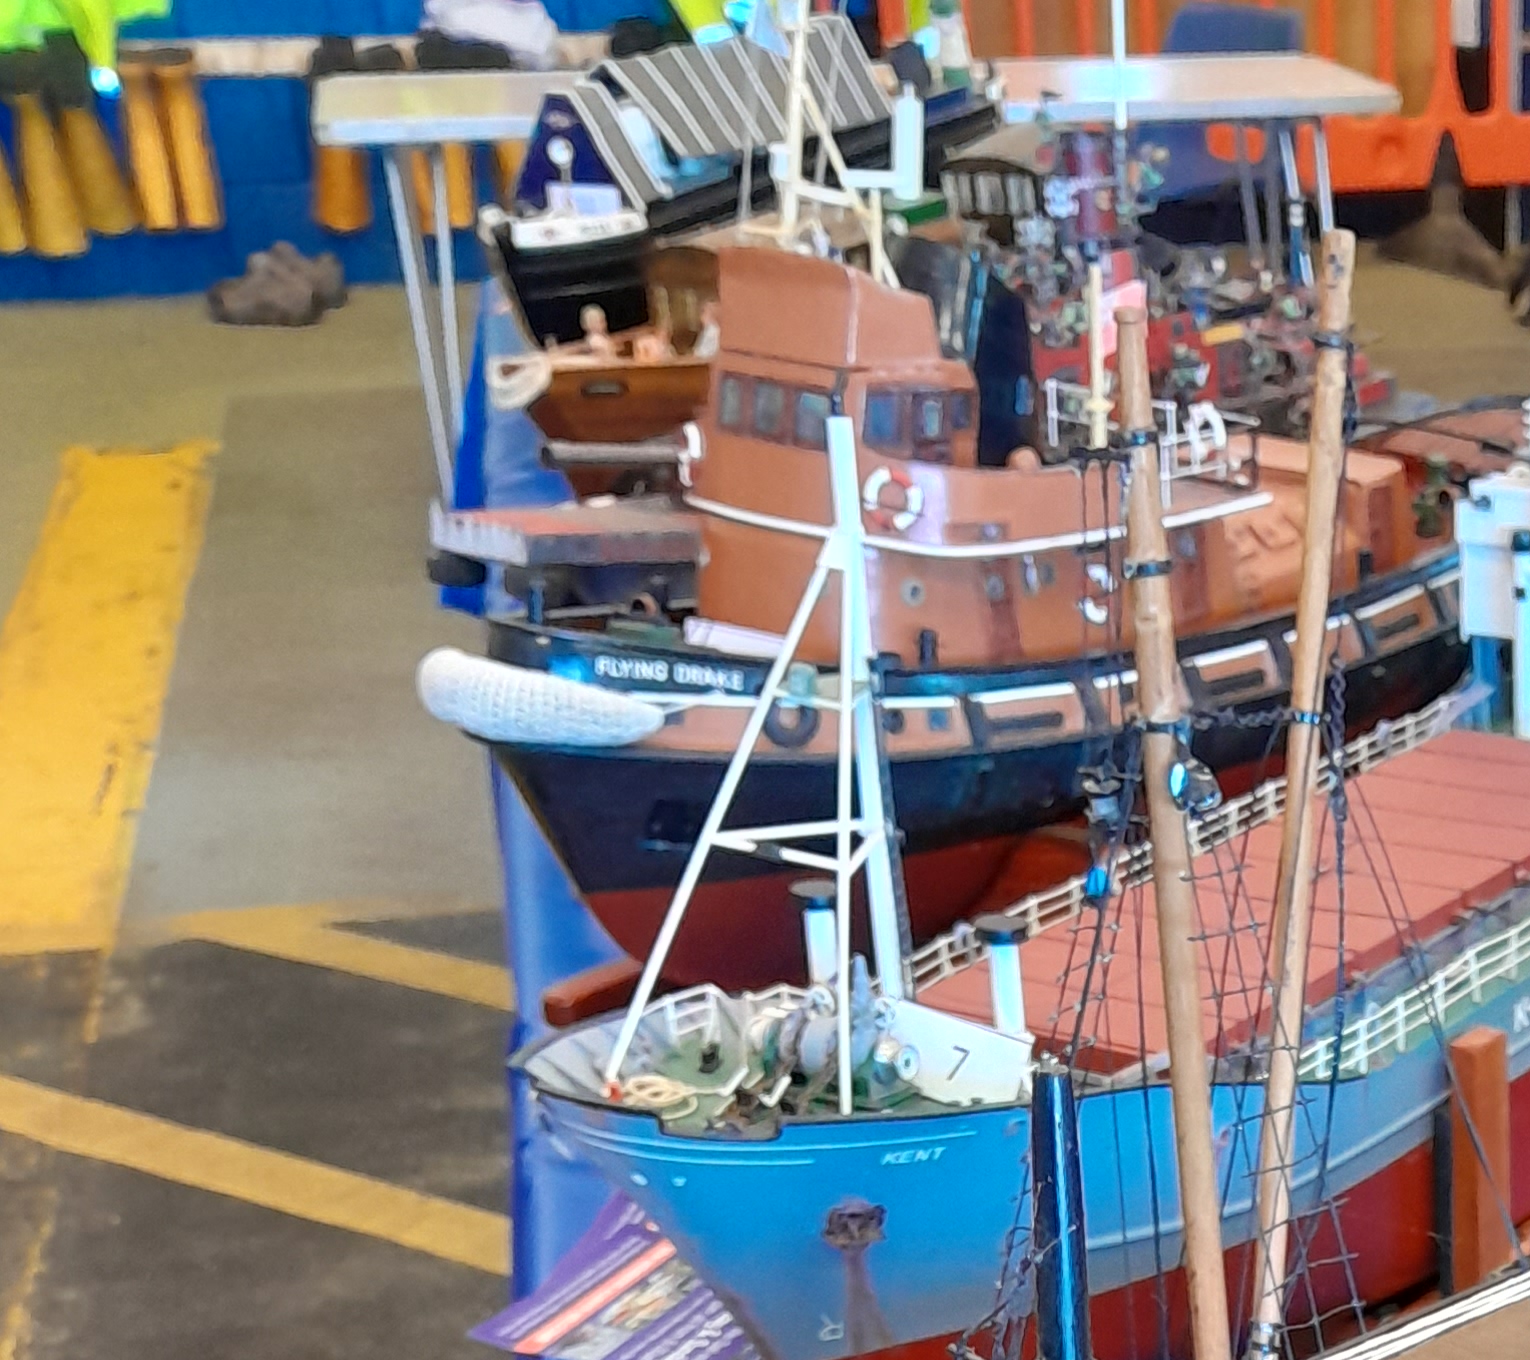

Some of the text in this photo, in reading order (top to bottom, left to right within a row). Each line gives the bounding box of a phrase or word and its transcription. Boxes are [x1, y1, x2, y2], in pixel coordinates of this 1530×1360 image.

[594, 655, 744, 691] FLYING DRAKE
[946, 1045, 970, 1080] 7
[880, 1147, 946, 1165] KENT
